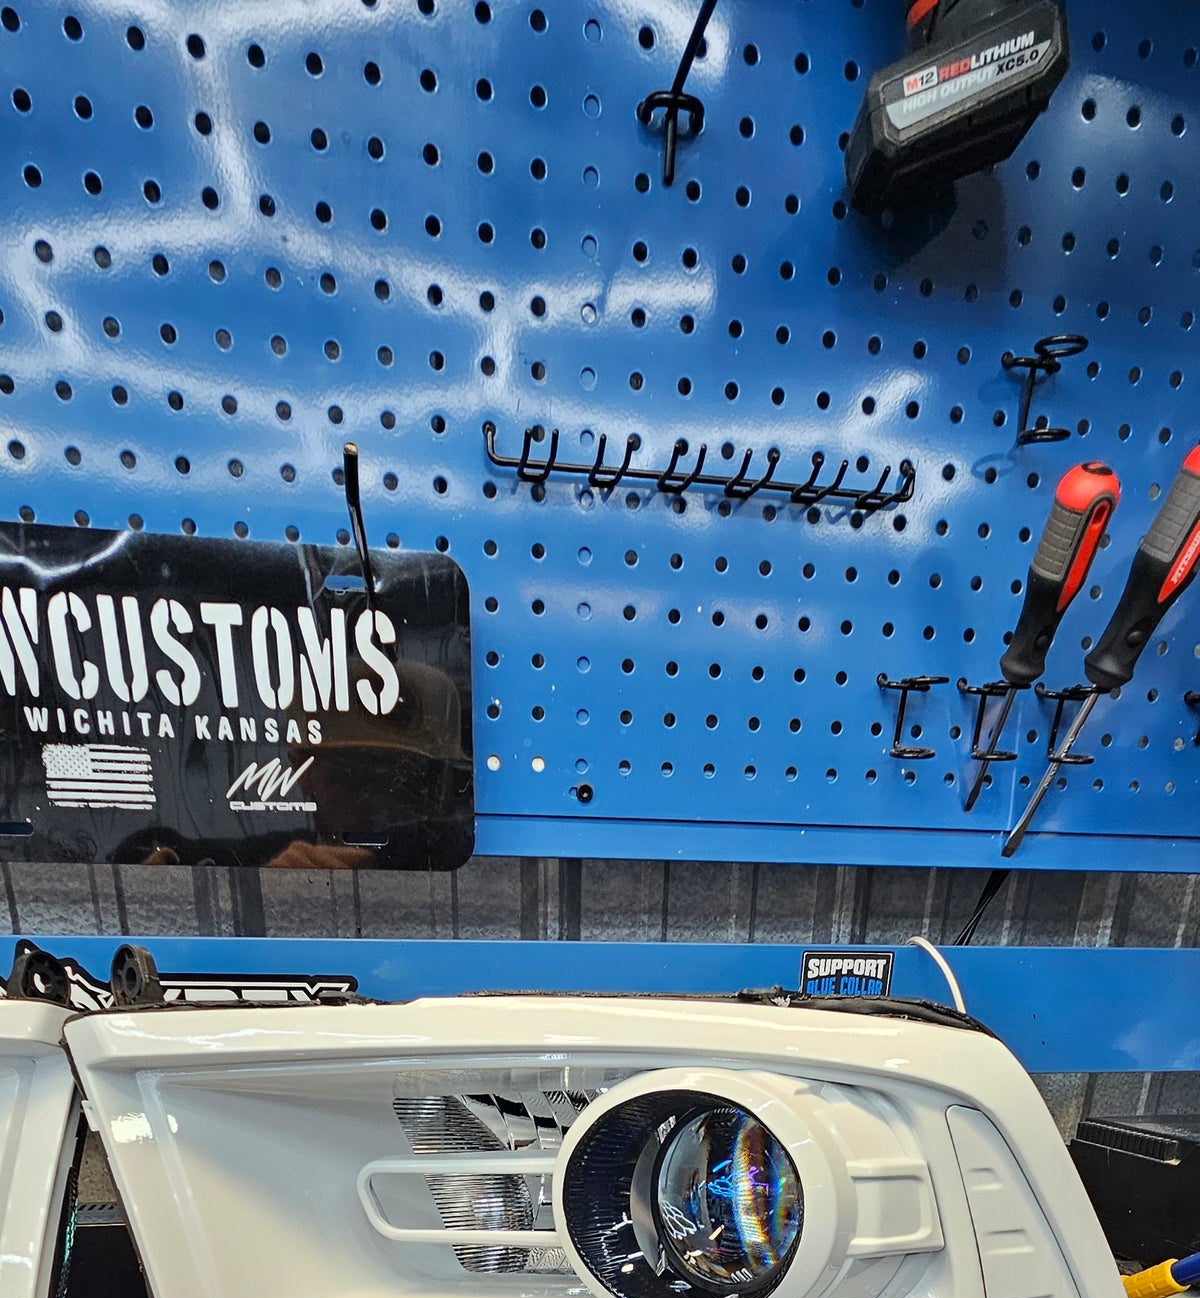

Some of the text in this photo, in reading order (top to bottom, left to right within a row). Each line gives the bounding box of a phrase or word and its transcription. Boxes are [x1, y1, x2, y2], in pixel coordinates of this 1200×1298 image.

[902, 49, 1039, 112] HIGH OUTPUT XC5.0
[907, 31, 1034, 92] M12 REDLITHIUM
[24, 706, 323, 745] WICHITA KANSAS
[226, 756, 315, 802] MW
[806, 976, 883, 995] BLUE COLLAR
[807, 958, 886, 978] SUPPORT
